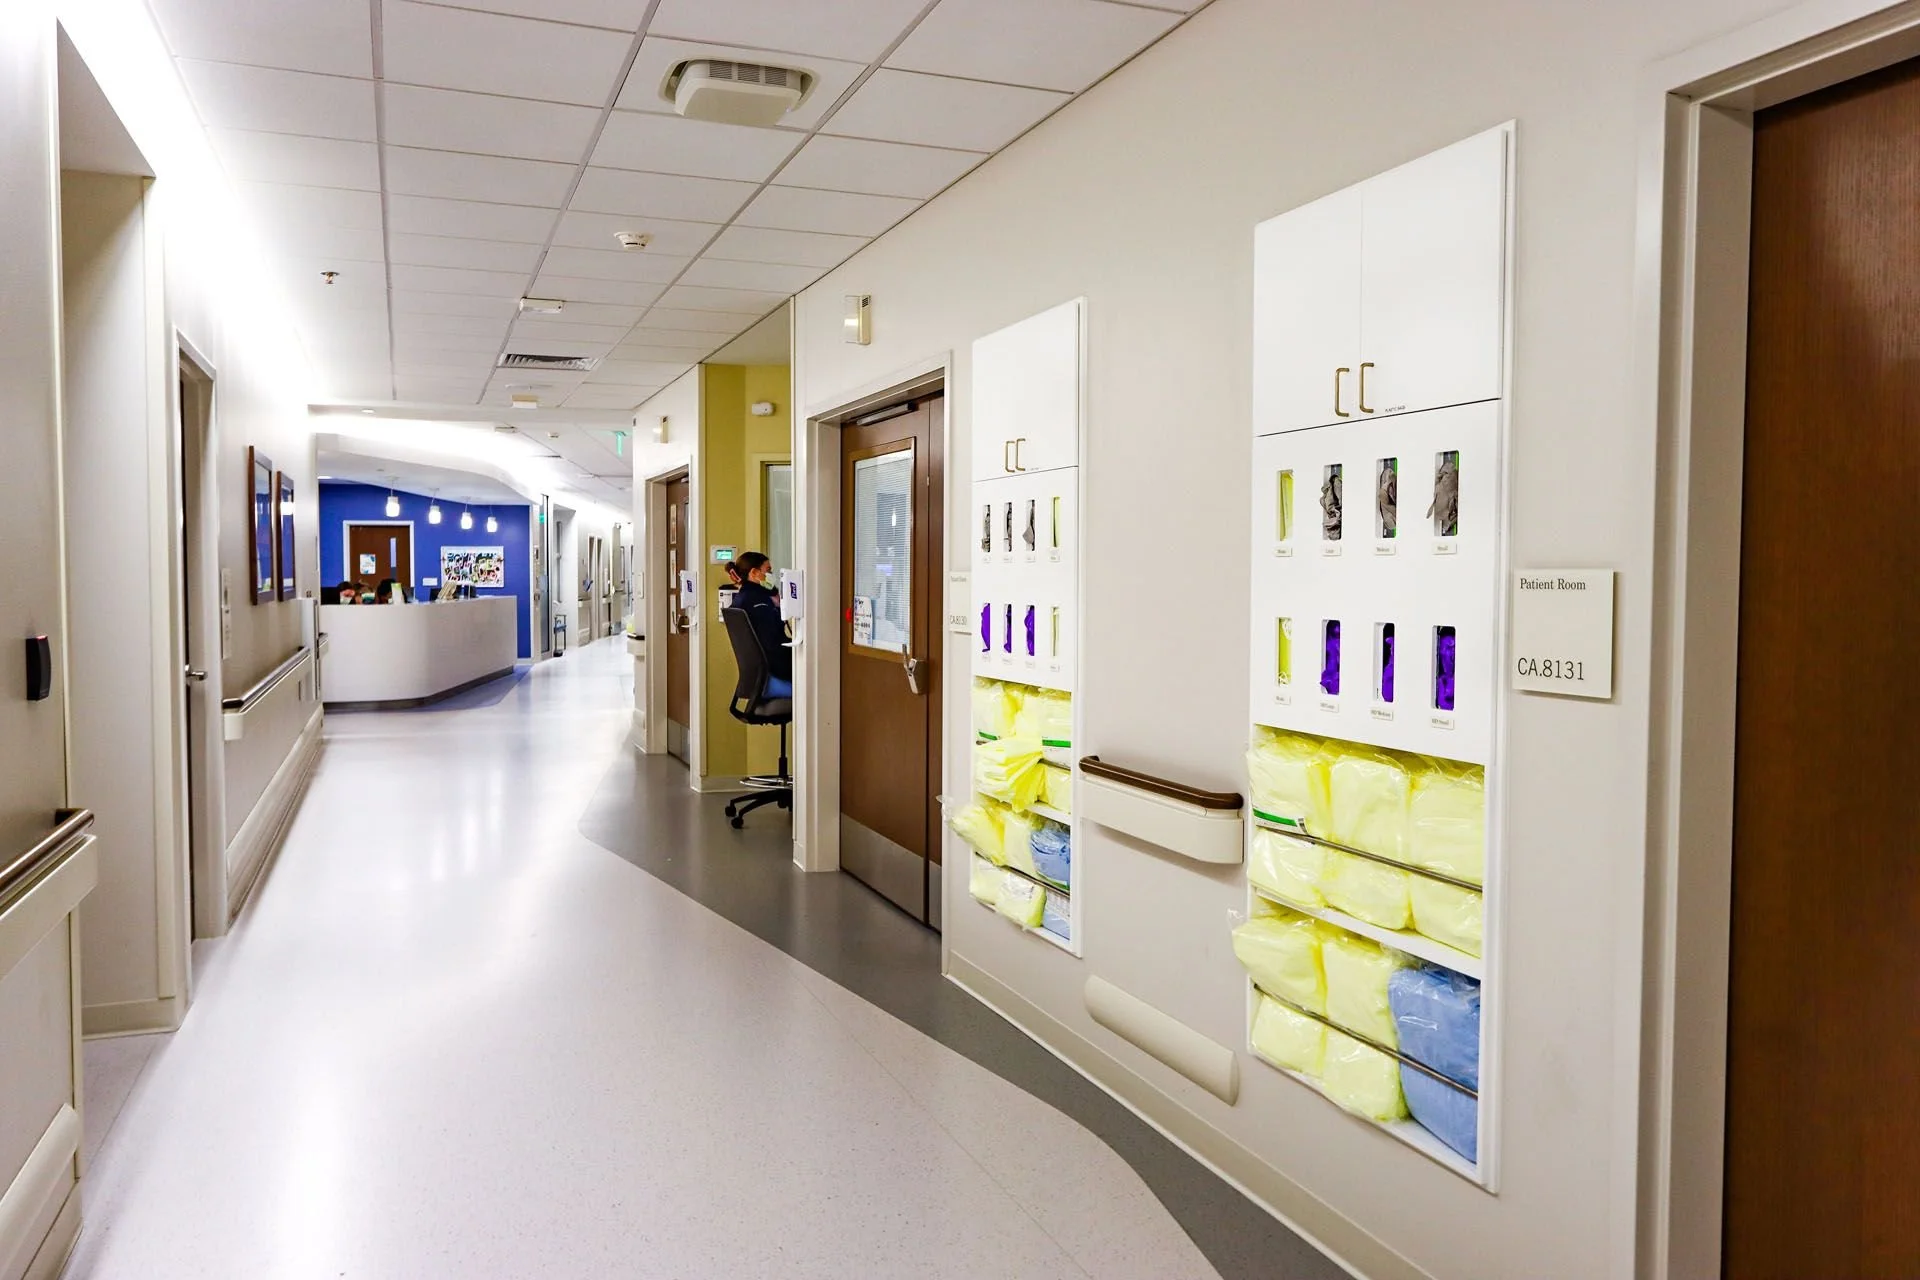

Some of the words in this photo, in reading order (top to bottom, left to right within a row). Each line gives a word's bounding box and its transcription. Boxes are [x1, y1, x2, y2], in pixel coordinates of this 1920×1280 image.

[1520, 578, 1553, 590] Patient
[1557, 578, 1586, 590] Room
[1517, 657, 1584, 681] CA.8131
